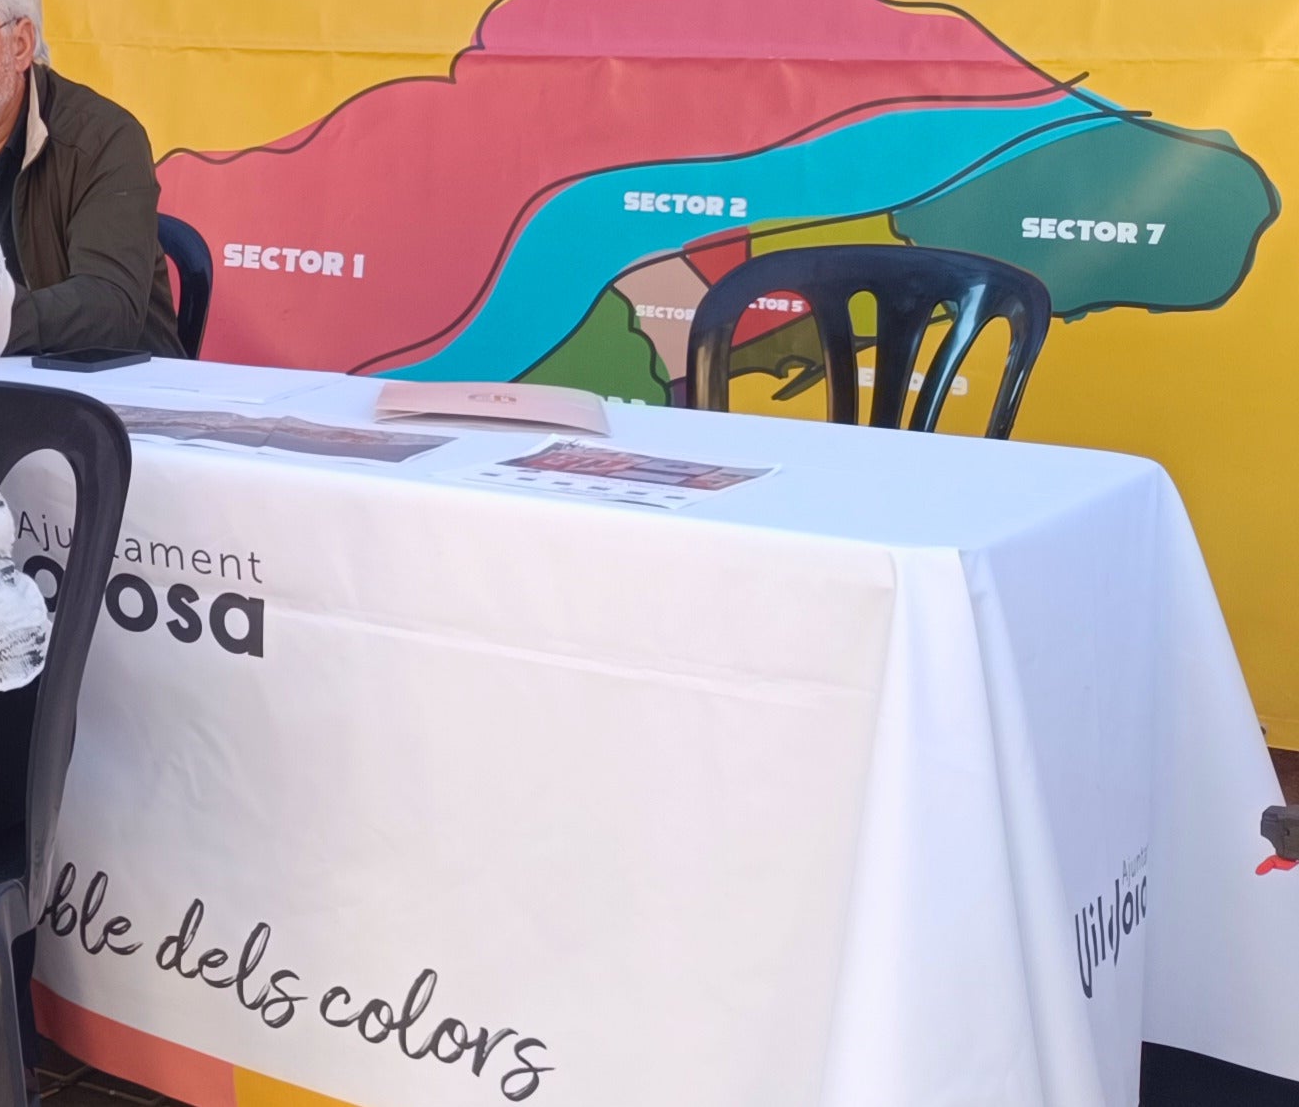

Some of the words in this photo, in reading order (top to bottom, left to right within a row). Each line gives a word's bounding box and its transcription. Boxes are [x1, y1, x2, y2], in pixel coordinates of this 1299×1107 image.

[623, 191, 725, 216] SECTOR
[728, 197, 748, 218] 2
[1022, 217, 1138, 244] SECTOR
[1146, 223, 1166, 245] 7
[223, 243, 344, 277] SECTOR
[352, 254, 365, 278] 1
[17, 511, 263, 584] Ajuament
[155, 898, 308, 1028] dels
[319, 968, 555, 1101] colors
